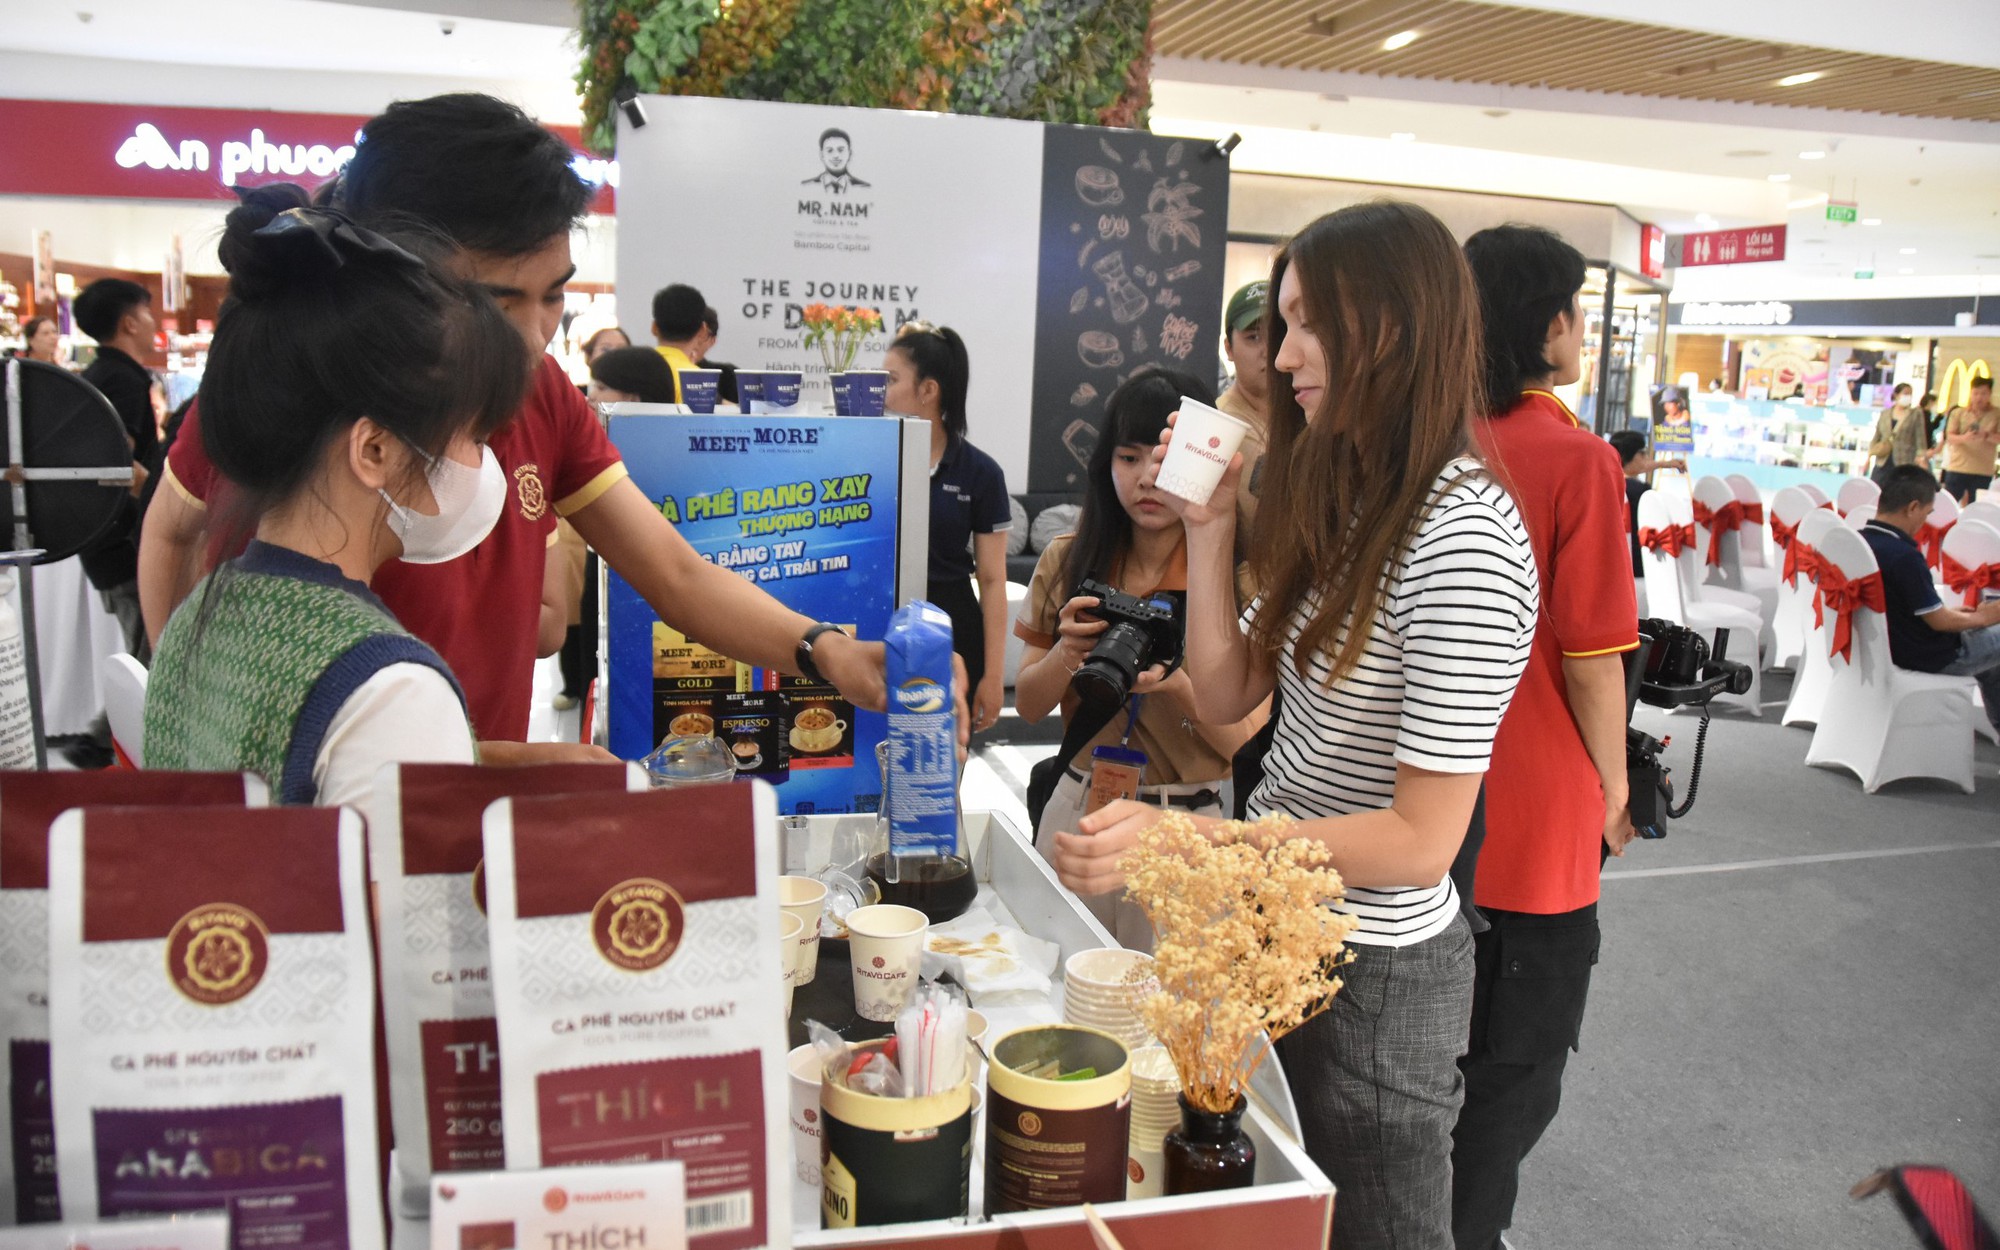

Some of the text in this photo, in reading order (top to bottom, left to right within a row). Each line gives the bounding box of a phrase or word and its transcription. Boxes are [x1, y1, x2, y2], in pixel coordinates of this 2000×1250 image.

[743, 279, 918, 302] THE JOURNEY
[742, 302, 773, 319] OF
[758, 337, 798, 349] FROM
[864, 340, 890, 352] SOU
[688, 427, 819, 452] MEET MORE
[685, 488, 737, 521] PHÊ
[741, 481, 816, 514] RANG
[820, 473, 872, 503] XAY
[738, 503, 872, 538] THƯỢNG HẠNG
[772, 540, 805, 562] TAY
[783, 559, 818, 580] TRÁI
[820, 555, 849, 573] TIM
[661, 648, 693, 657] MEET
[690, 659, 726, 669] MORE
[677, 678, 713, 688] GOLD
[722, 718, 770, 728] ESPRESSO
[581, 1013, 612, 1029] PHÊ
[618, 1007, 686, 1026] NGUYÊN
[446, 1118, 484, 1136] 250
[544, 1222, 647, 1250] THÍCH
